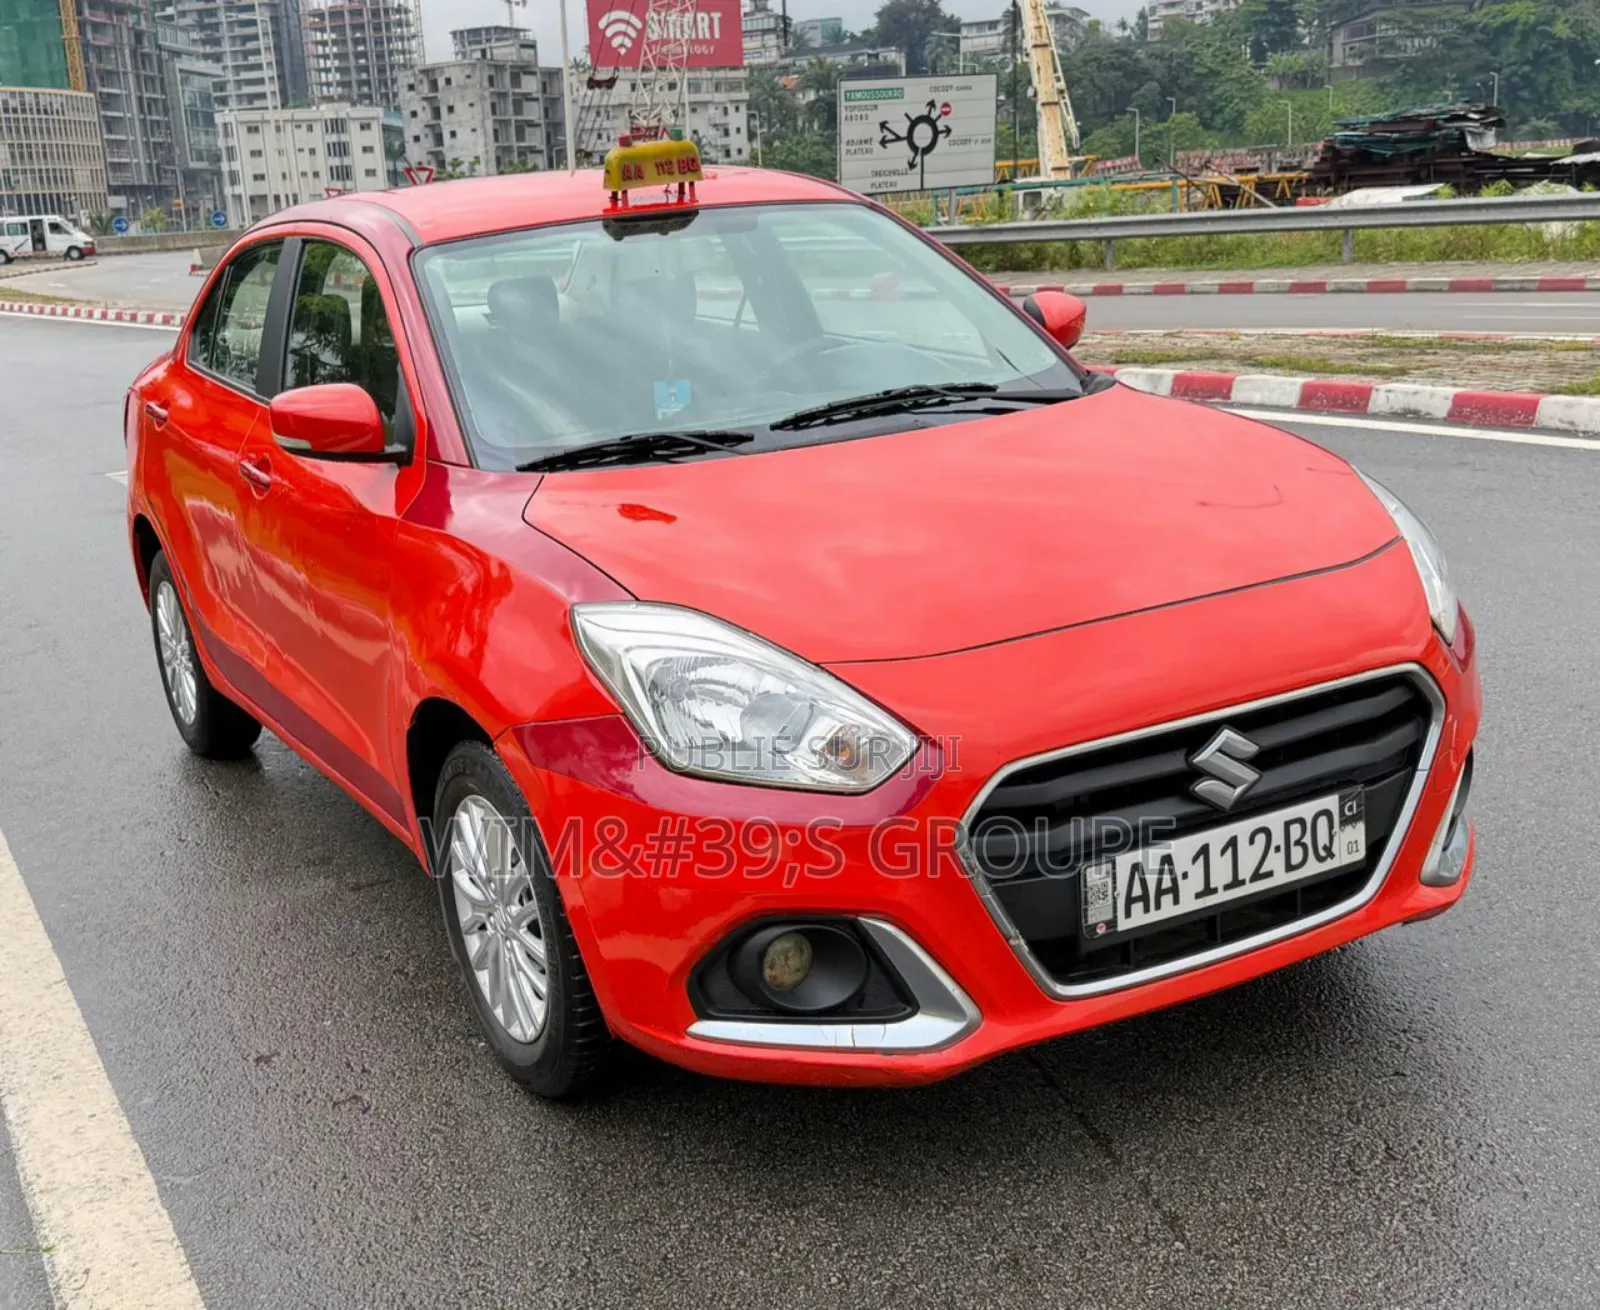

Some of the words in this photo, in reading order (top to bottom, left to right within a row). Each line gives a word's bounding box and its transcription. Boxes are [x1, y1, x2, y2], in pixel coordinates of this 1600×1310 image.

[622, 163, 644, 181] AA
[655, 159, 675, 177] 112
[1347, 839, 1360, 855] 01
